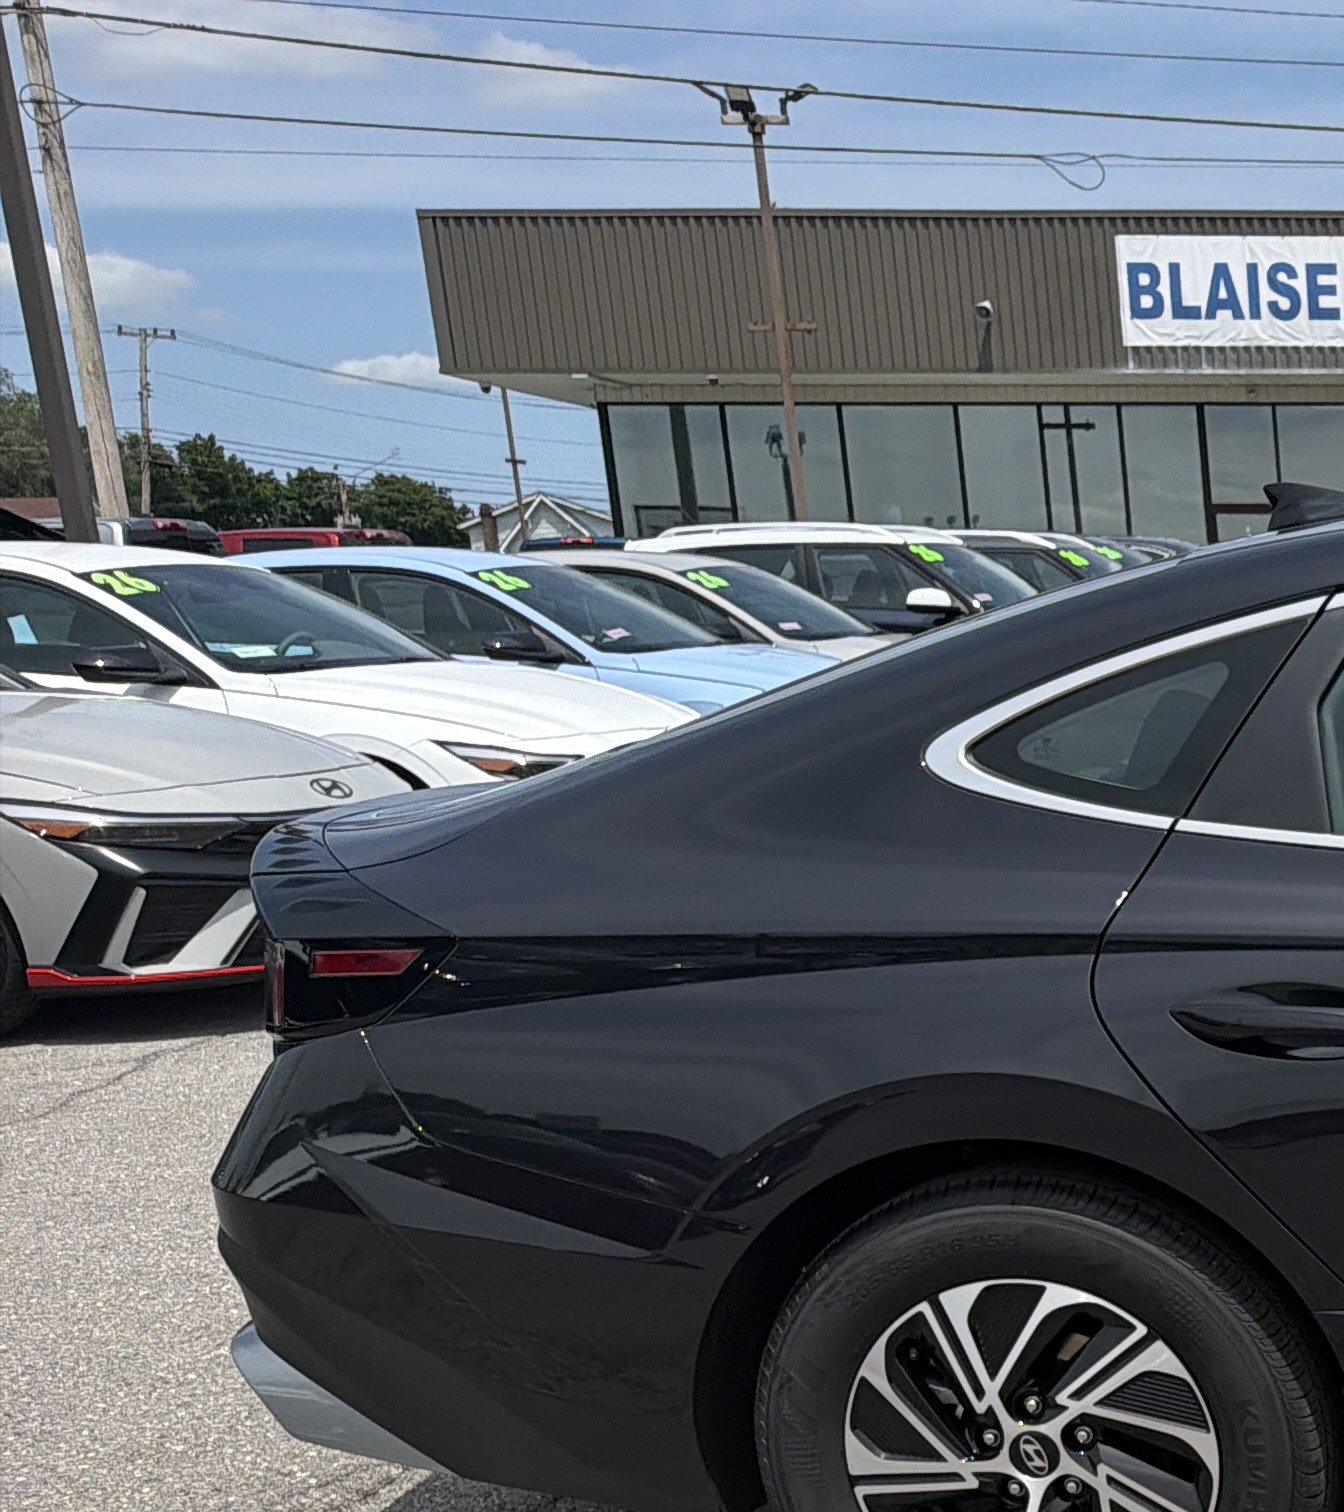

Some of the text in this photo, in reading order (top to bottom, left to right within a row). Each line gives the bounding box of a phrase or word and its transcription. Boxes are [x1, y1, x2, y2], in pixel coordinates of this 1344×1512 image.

[1126, 261, 1341, 322] BLAISE
[90, 570, 161, 596] 26
[478, 570, 532, 591] 26
[686, 570, 730, 589] 26
